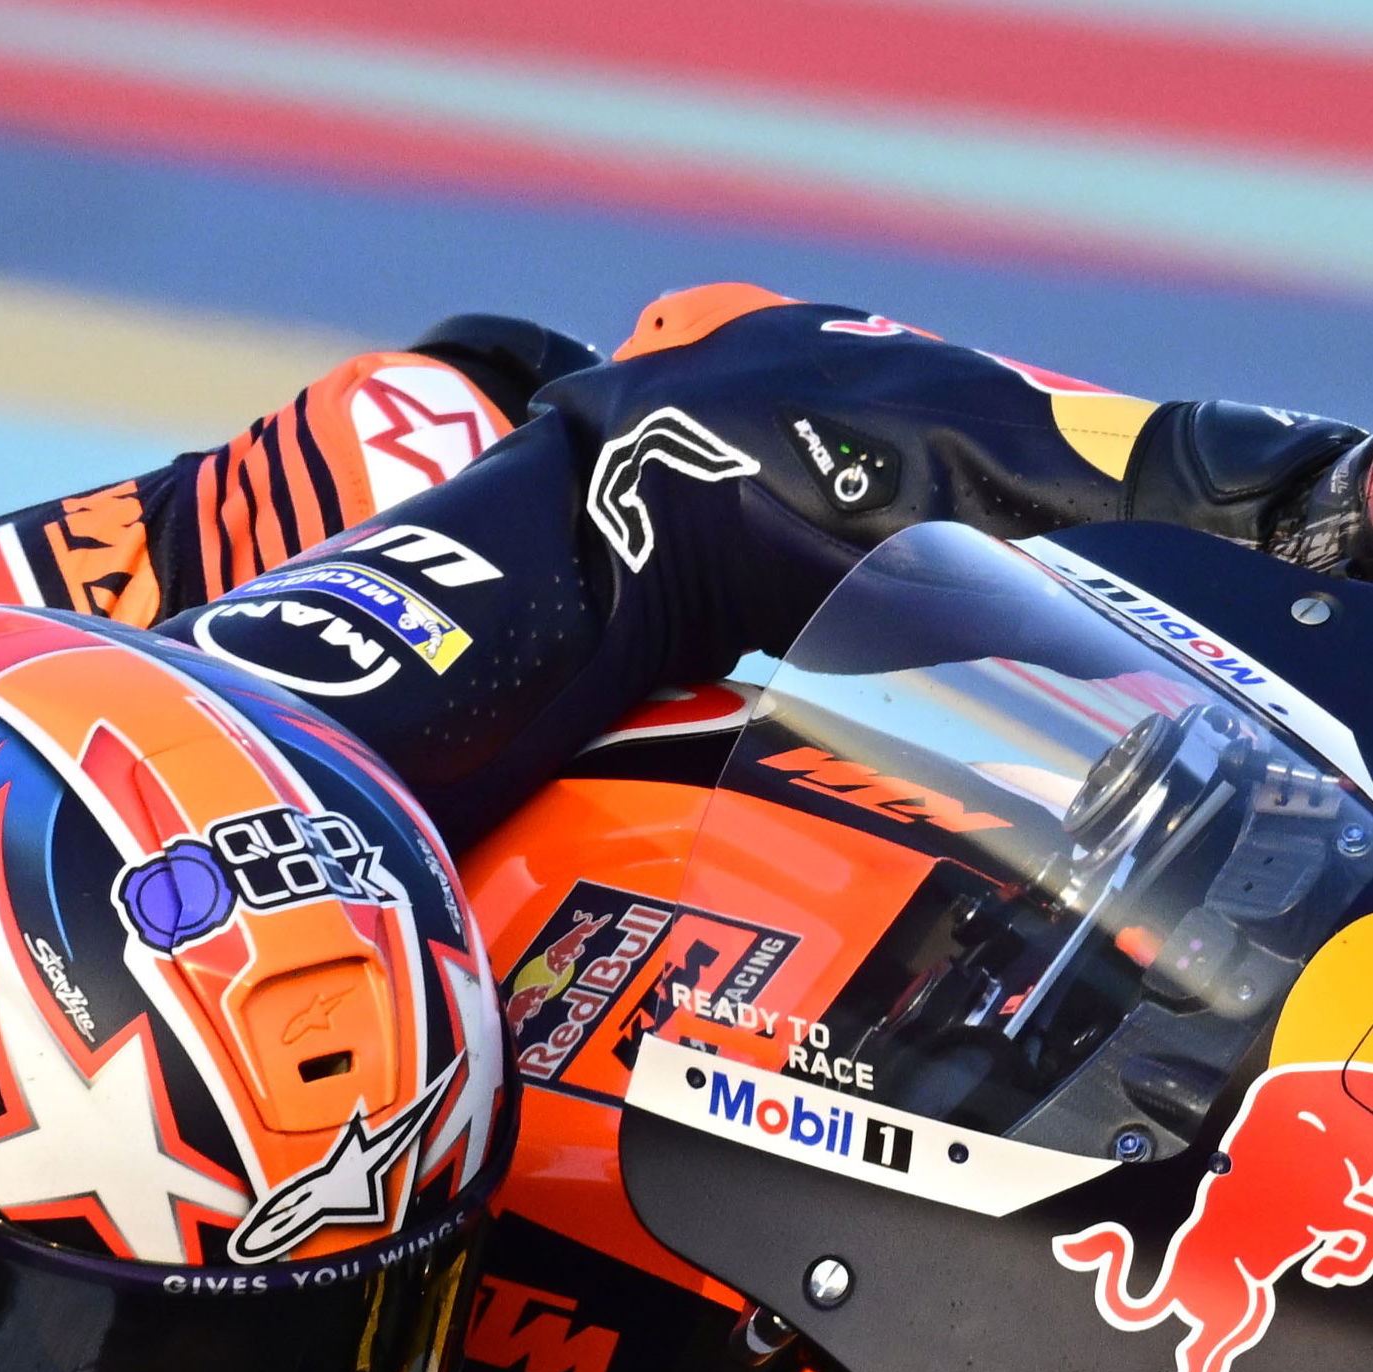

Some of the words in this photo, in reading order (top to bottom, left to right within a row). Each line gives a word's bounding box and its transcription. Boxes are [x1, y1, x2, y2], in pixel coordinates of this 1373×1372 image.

[1128, 605, 1267, 688] Mobil
[756, 746, 1014, 834] KTM
[518, 986, 609, 1080] Red
[584, 903, 674, 993] Bull
[672, 983, 780, 1036] READY
[788, 1015, 830, 1050] TO
[788, 1044, 874, 1091] RACE
[708, 1071, 854, 1157] Mobil
[163, 1275, 269, 1295] GIVES
[291, 1260, 361, 1288] YOU
